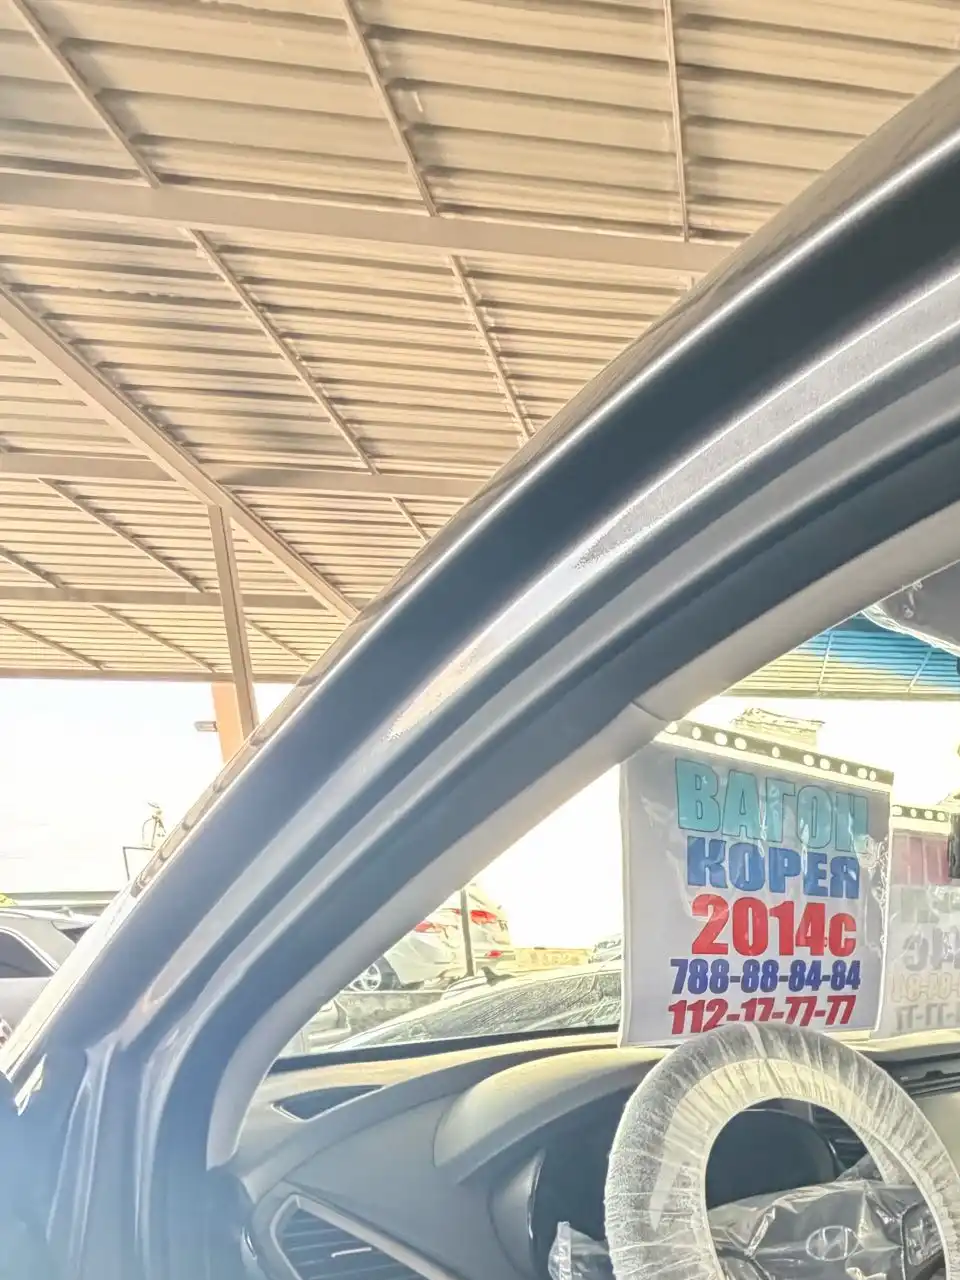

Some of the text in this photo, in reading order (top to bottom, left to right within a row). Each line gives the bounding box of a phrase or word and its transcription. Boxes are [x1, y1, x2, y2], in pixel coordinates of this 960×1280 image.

[675, 758, 869, 854] ВАГОН
[687, 836, 860, 900] КОРЕЯ
[670, 958, 861, 995] 788-88-84-84
[668, 994, 857, 1035] 112-17-77-77
